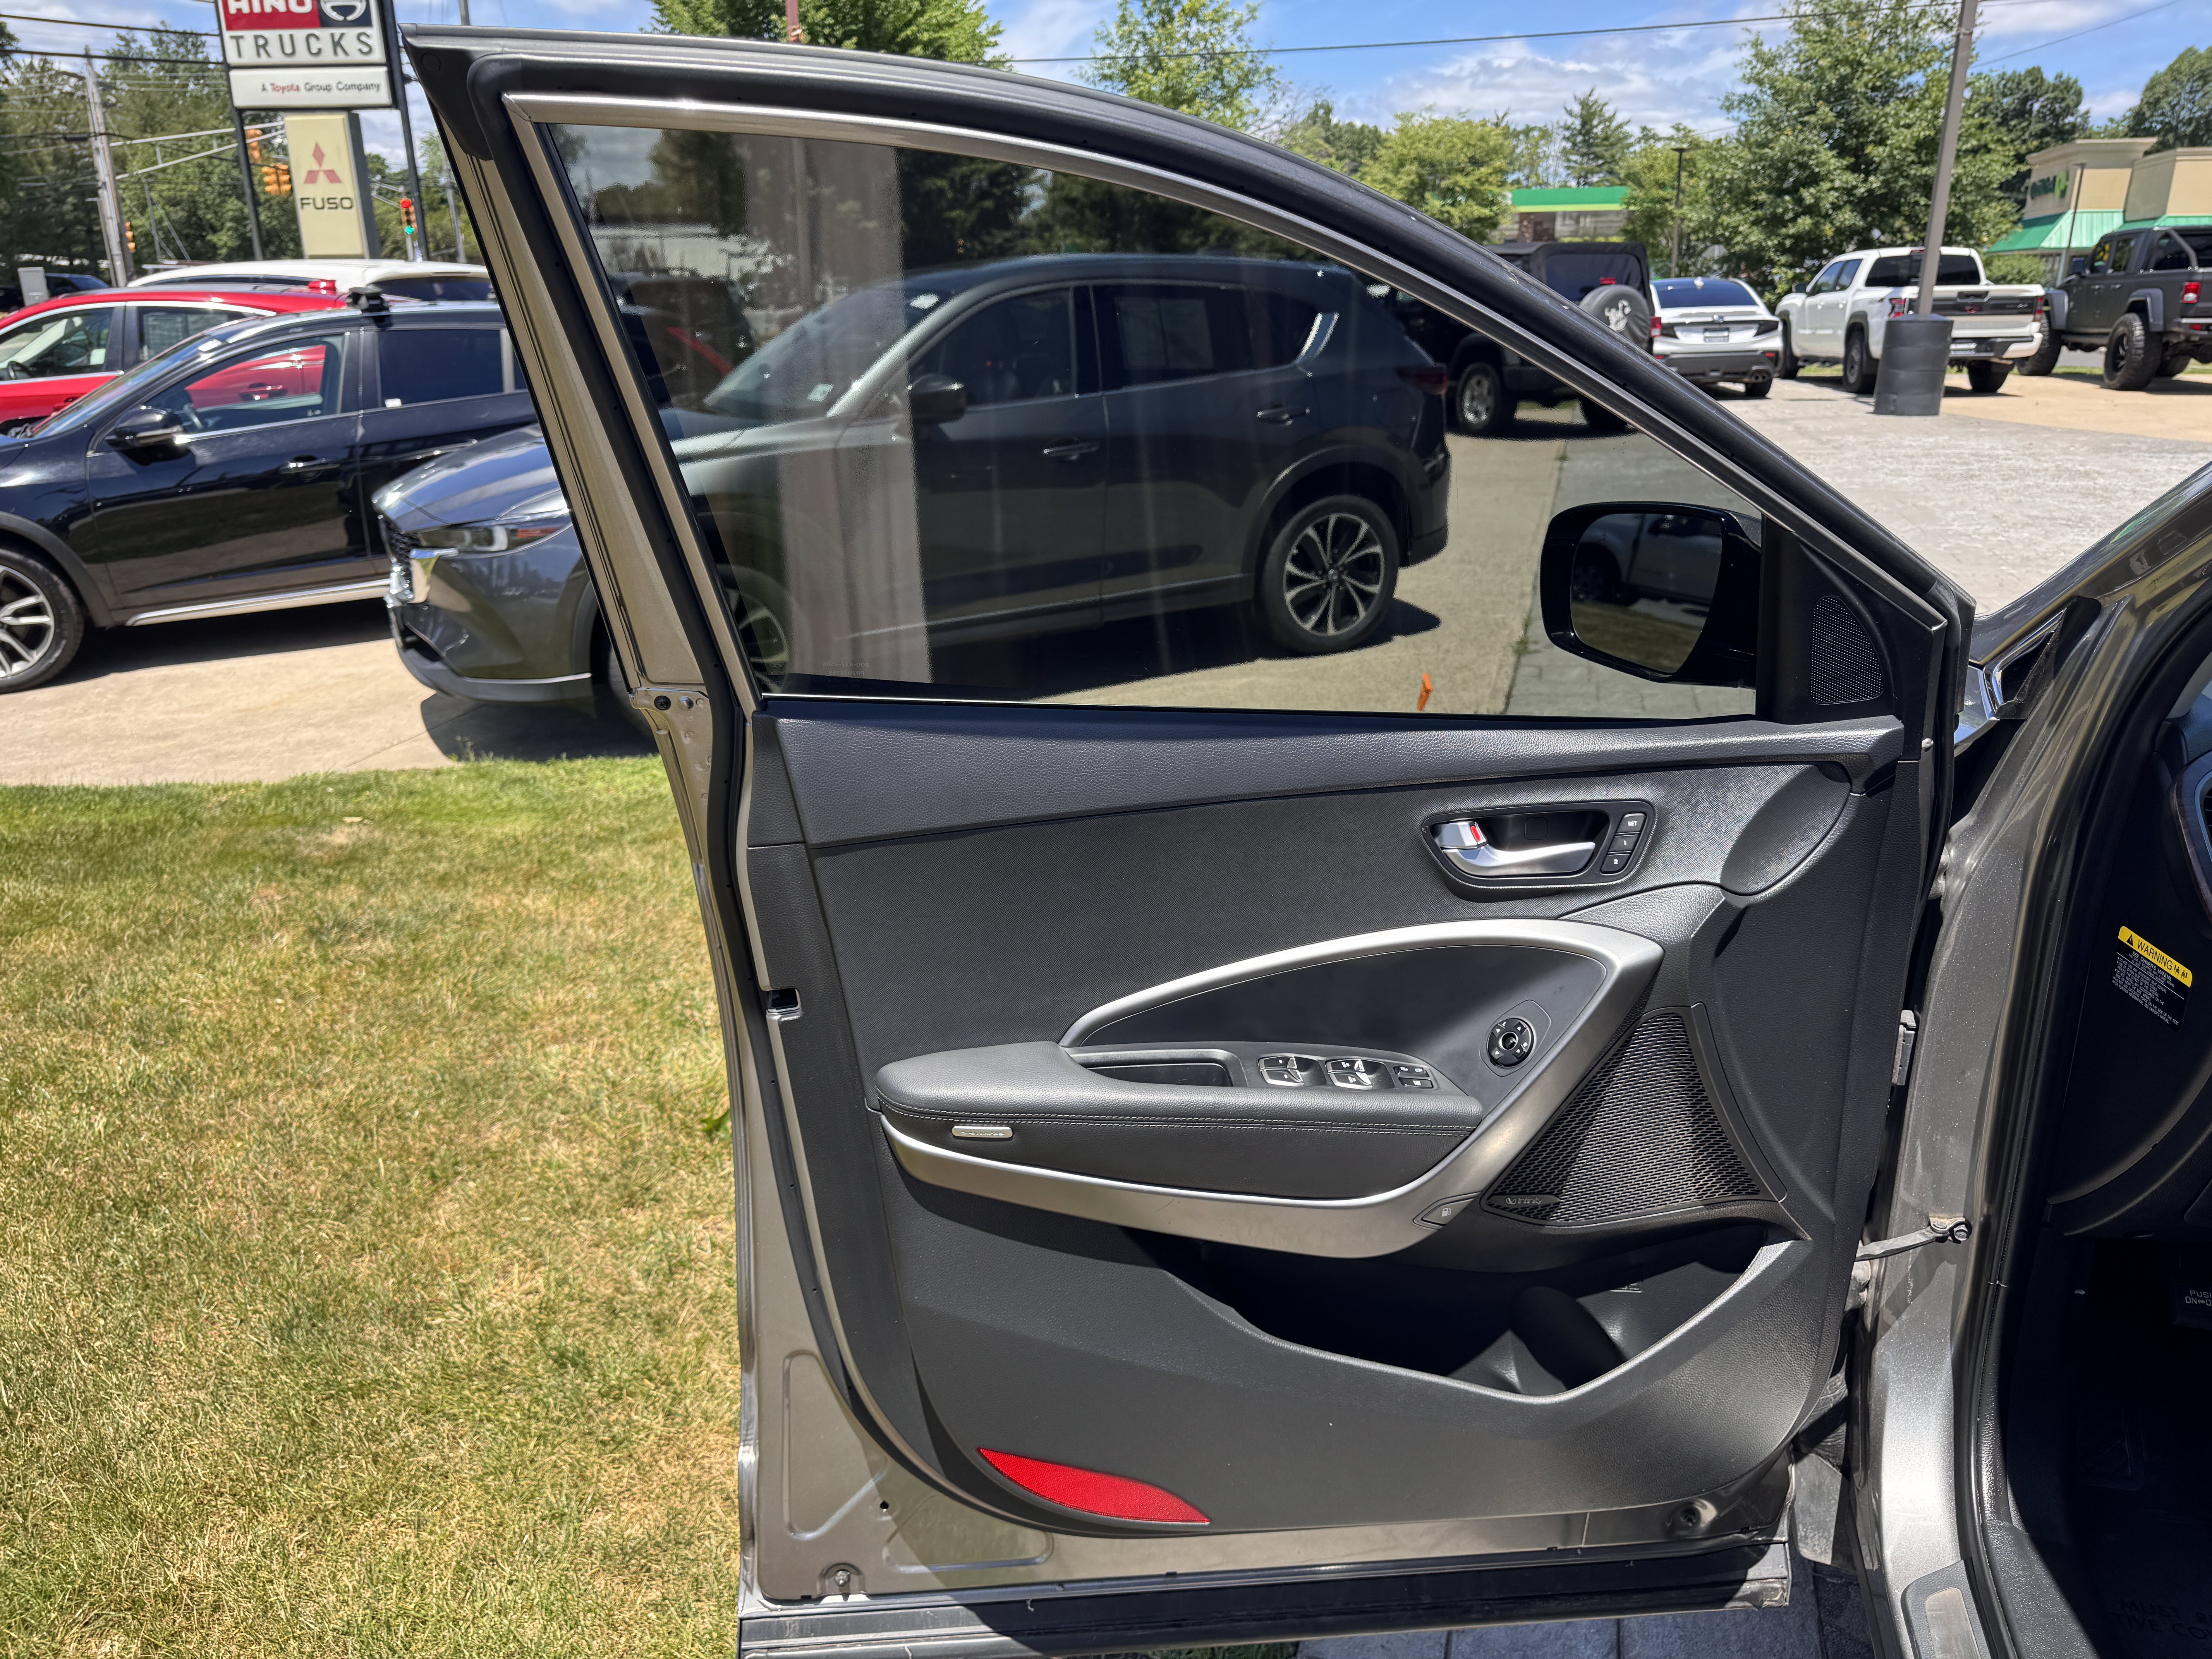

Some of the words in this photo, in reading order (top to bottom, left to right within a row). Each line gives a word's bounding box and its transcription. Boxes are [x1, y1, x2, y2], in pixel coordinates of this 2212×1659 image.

[230, 32, 373, 58] TRUCKS
[261, 83, 268, 92] A
[270, 82, 301, 94] Toyota
[304, 81, 333, 94] Group
[336, 81, 381, 93] Company
[299, 196, 354, 210] FUSO
[2138, 939, 2173, 970] WARNING
[2157, 968, 2172, 982] MANUAL
[2185, 1296, 2197, 1304] ON
[2120, 1598, 2180, 1620] MUST
[2195, 1612, 2212, 1626] R
